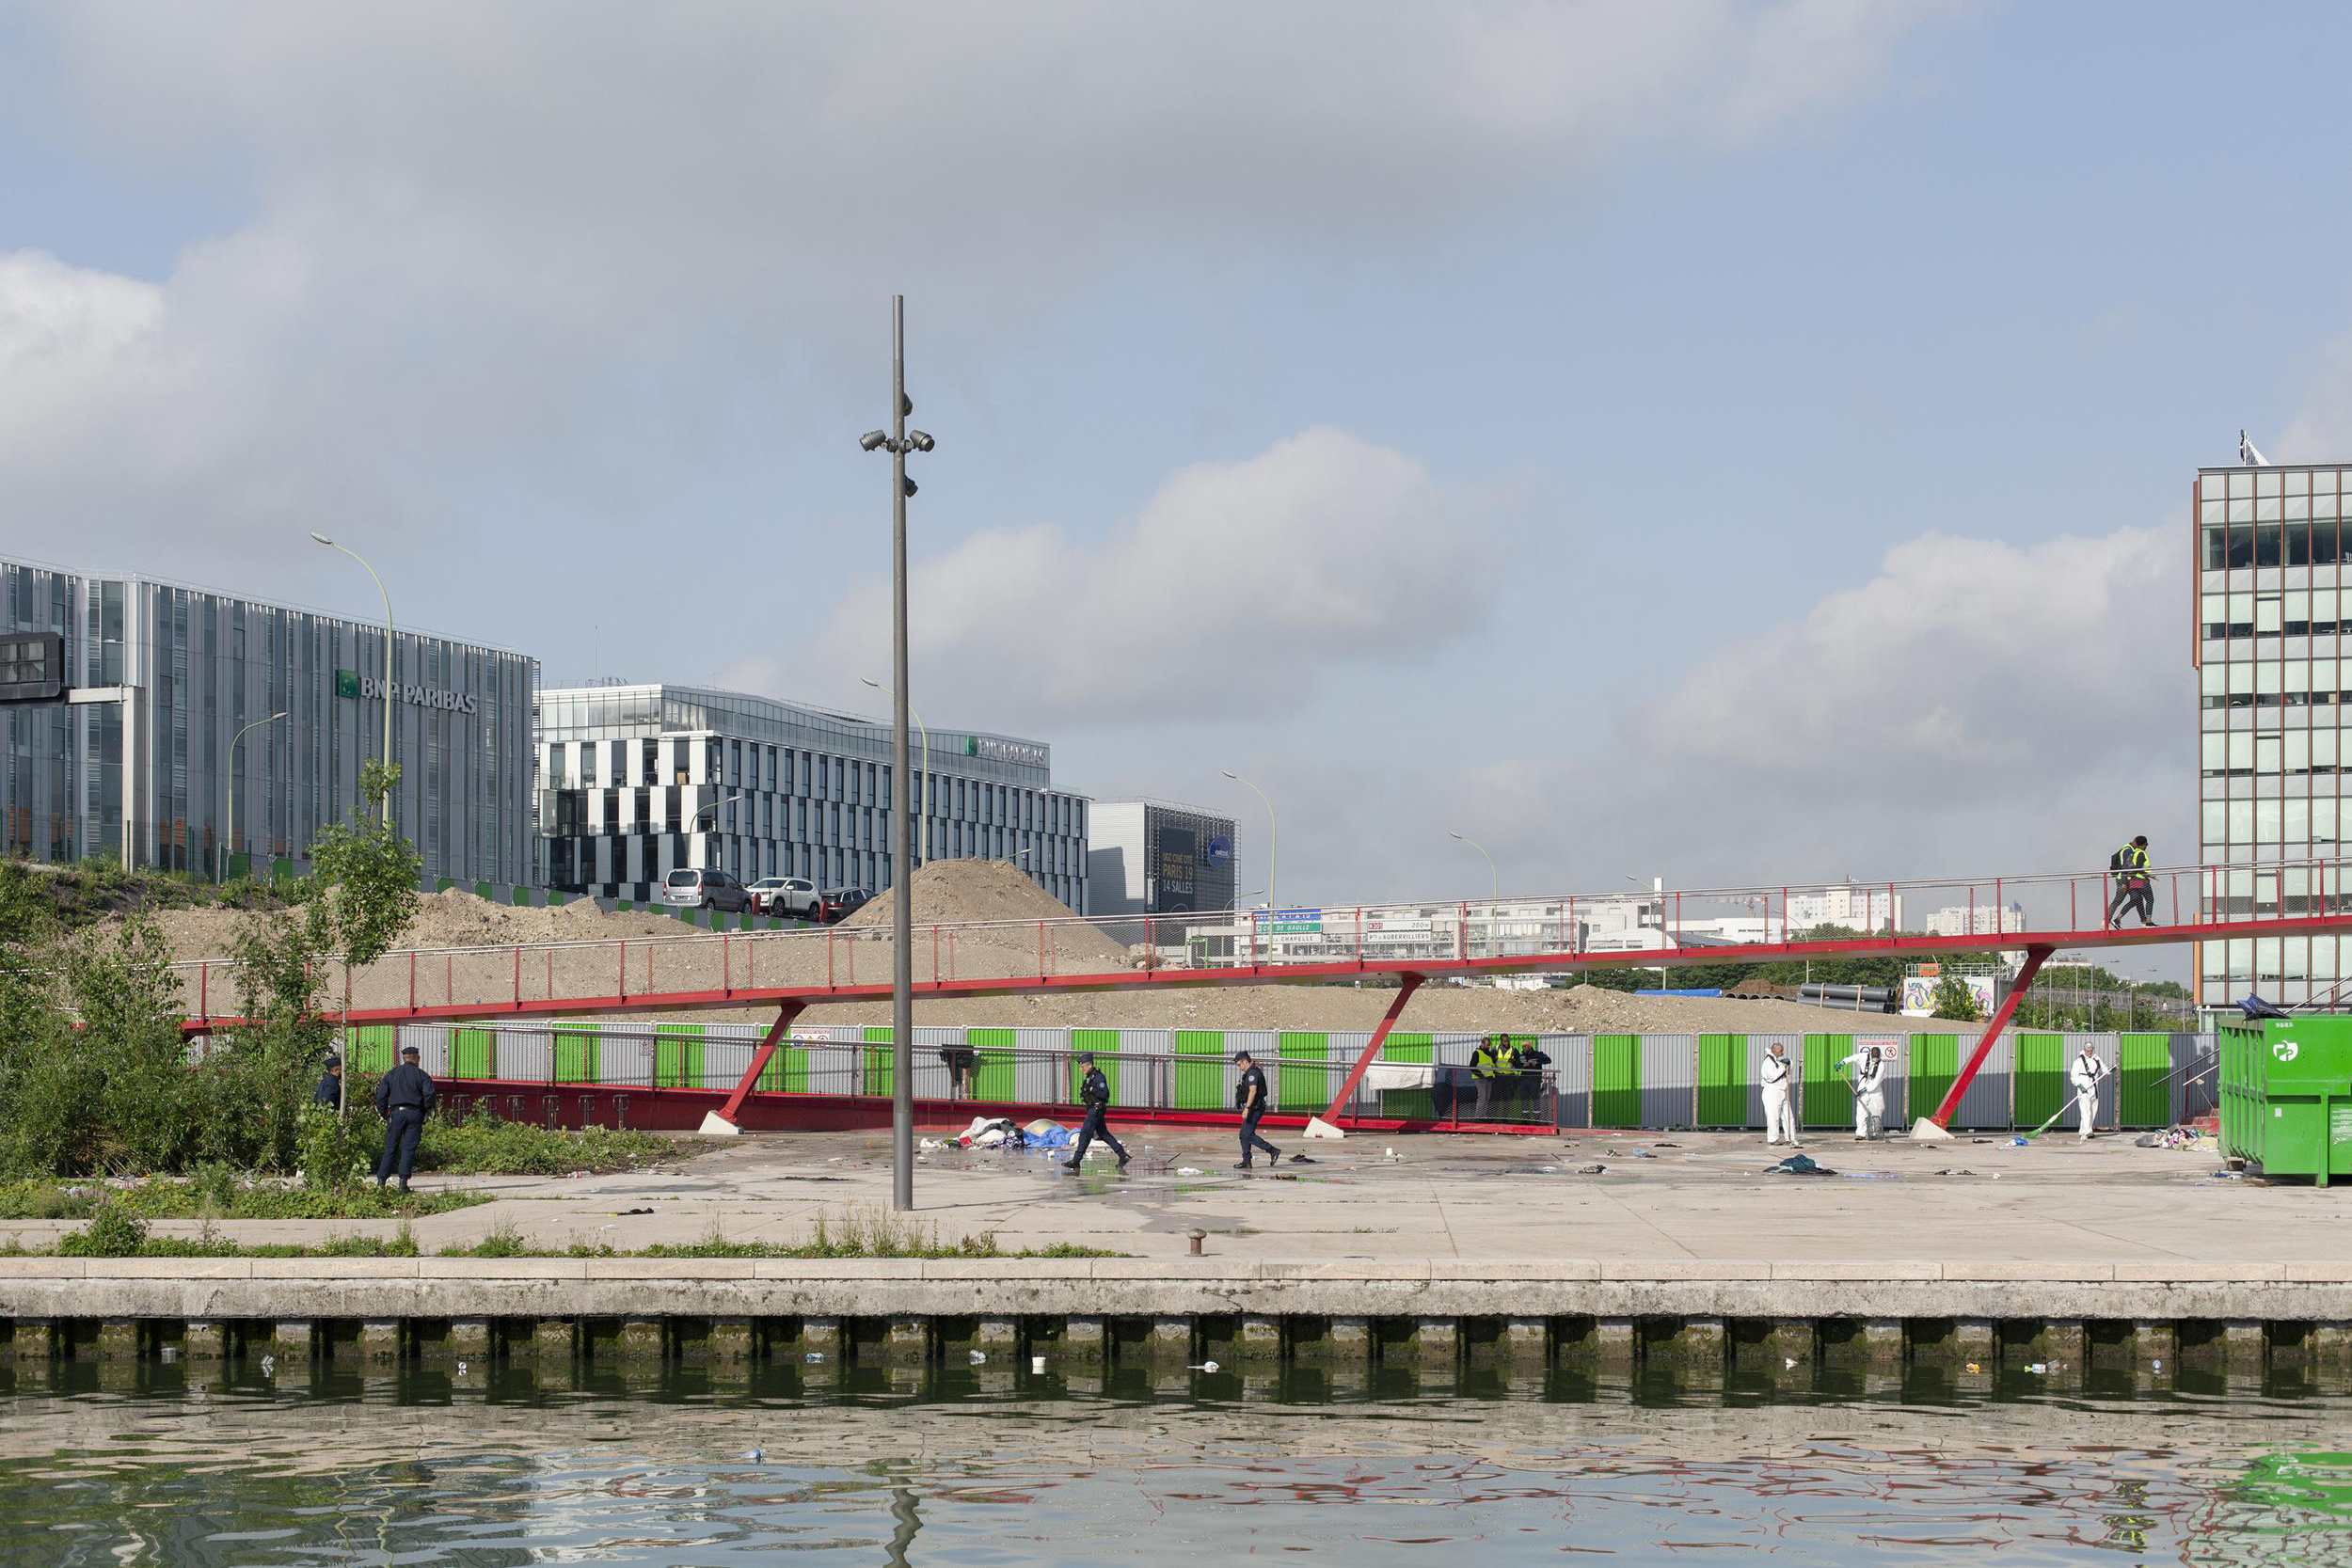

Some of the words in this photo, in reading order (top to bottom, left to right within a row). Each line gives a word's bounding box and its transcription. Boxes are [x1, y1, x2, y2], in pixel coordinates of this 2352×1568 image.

[361, 676, 401, 702] BNP
[403, 683, 477, 715] PARIBAS
[1163, 863, 1184, 879] PARIS
[1185, 865, 1194, 880] 19
[1163, 879, 1170, 892] 14
[1171, 880, 1194, 895] SALLES
